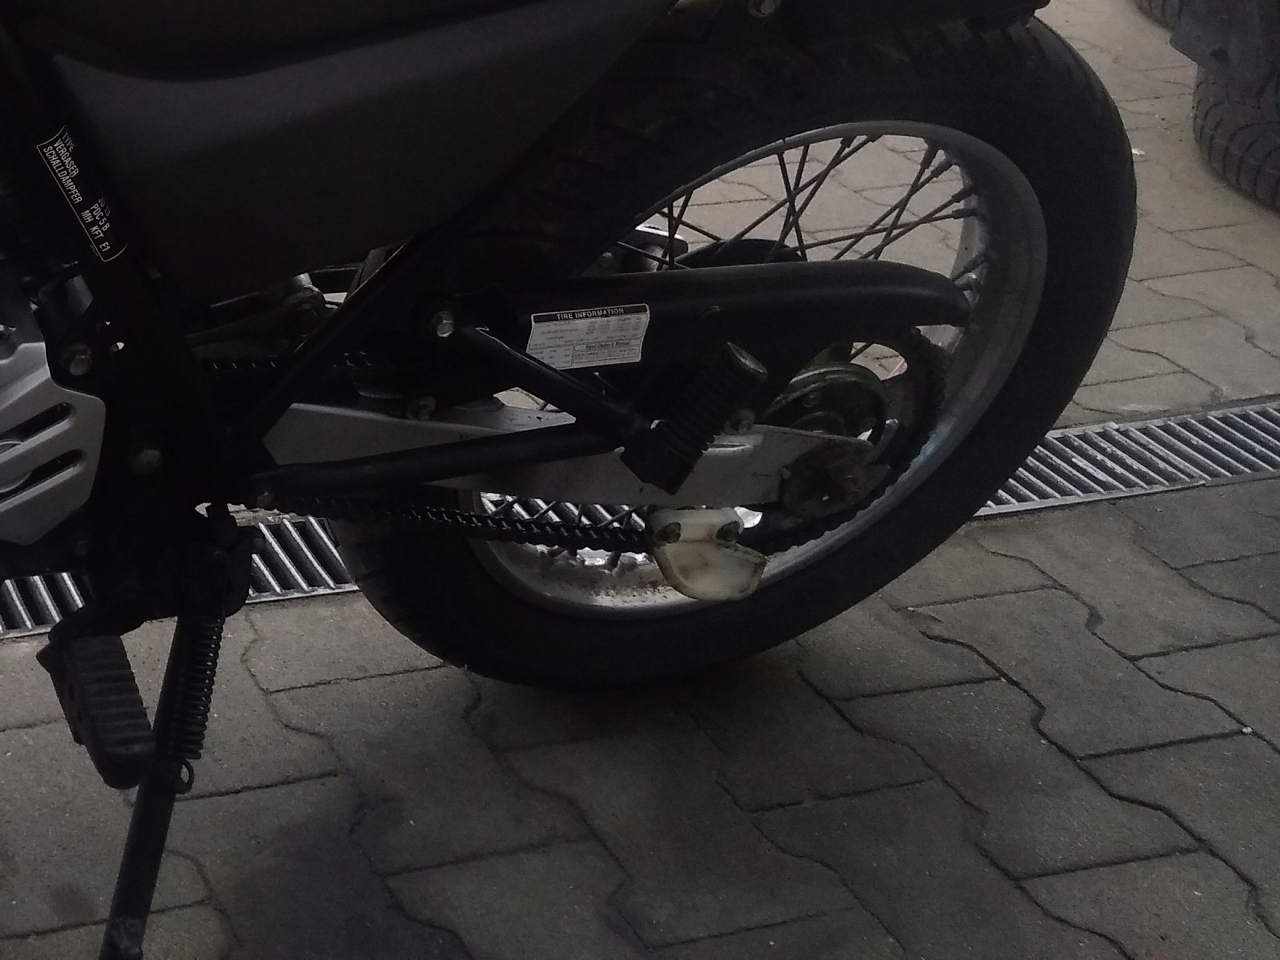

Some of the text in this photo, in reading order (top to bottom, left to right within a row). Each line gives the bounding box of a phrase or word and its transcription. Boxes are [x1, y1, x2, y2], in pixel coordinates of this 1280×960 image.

[53, 138, 80, 178] VERGASER
[556, 308, 624, 321] TIRE INFORMATION
